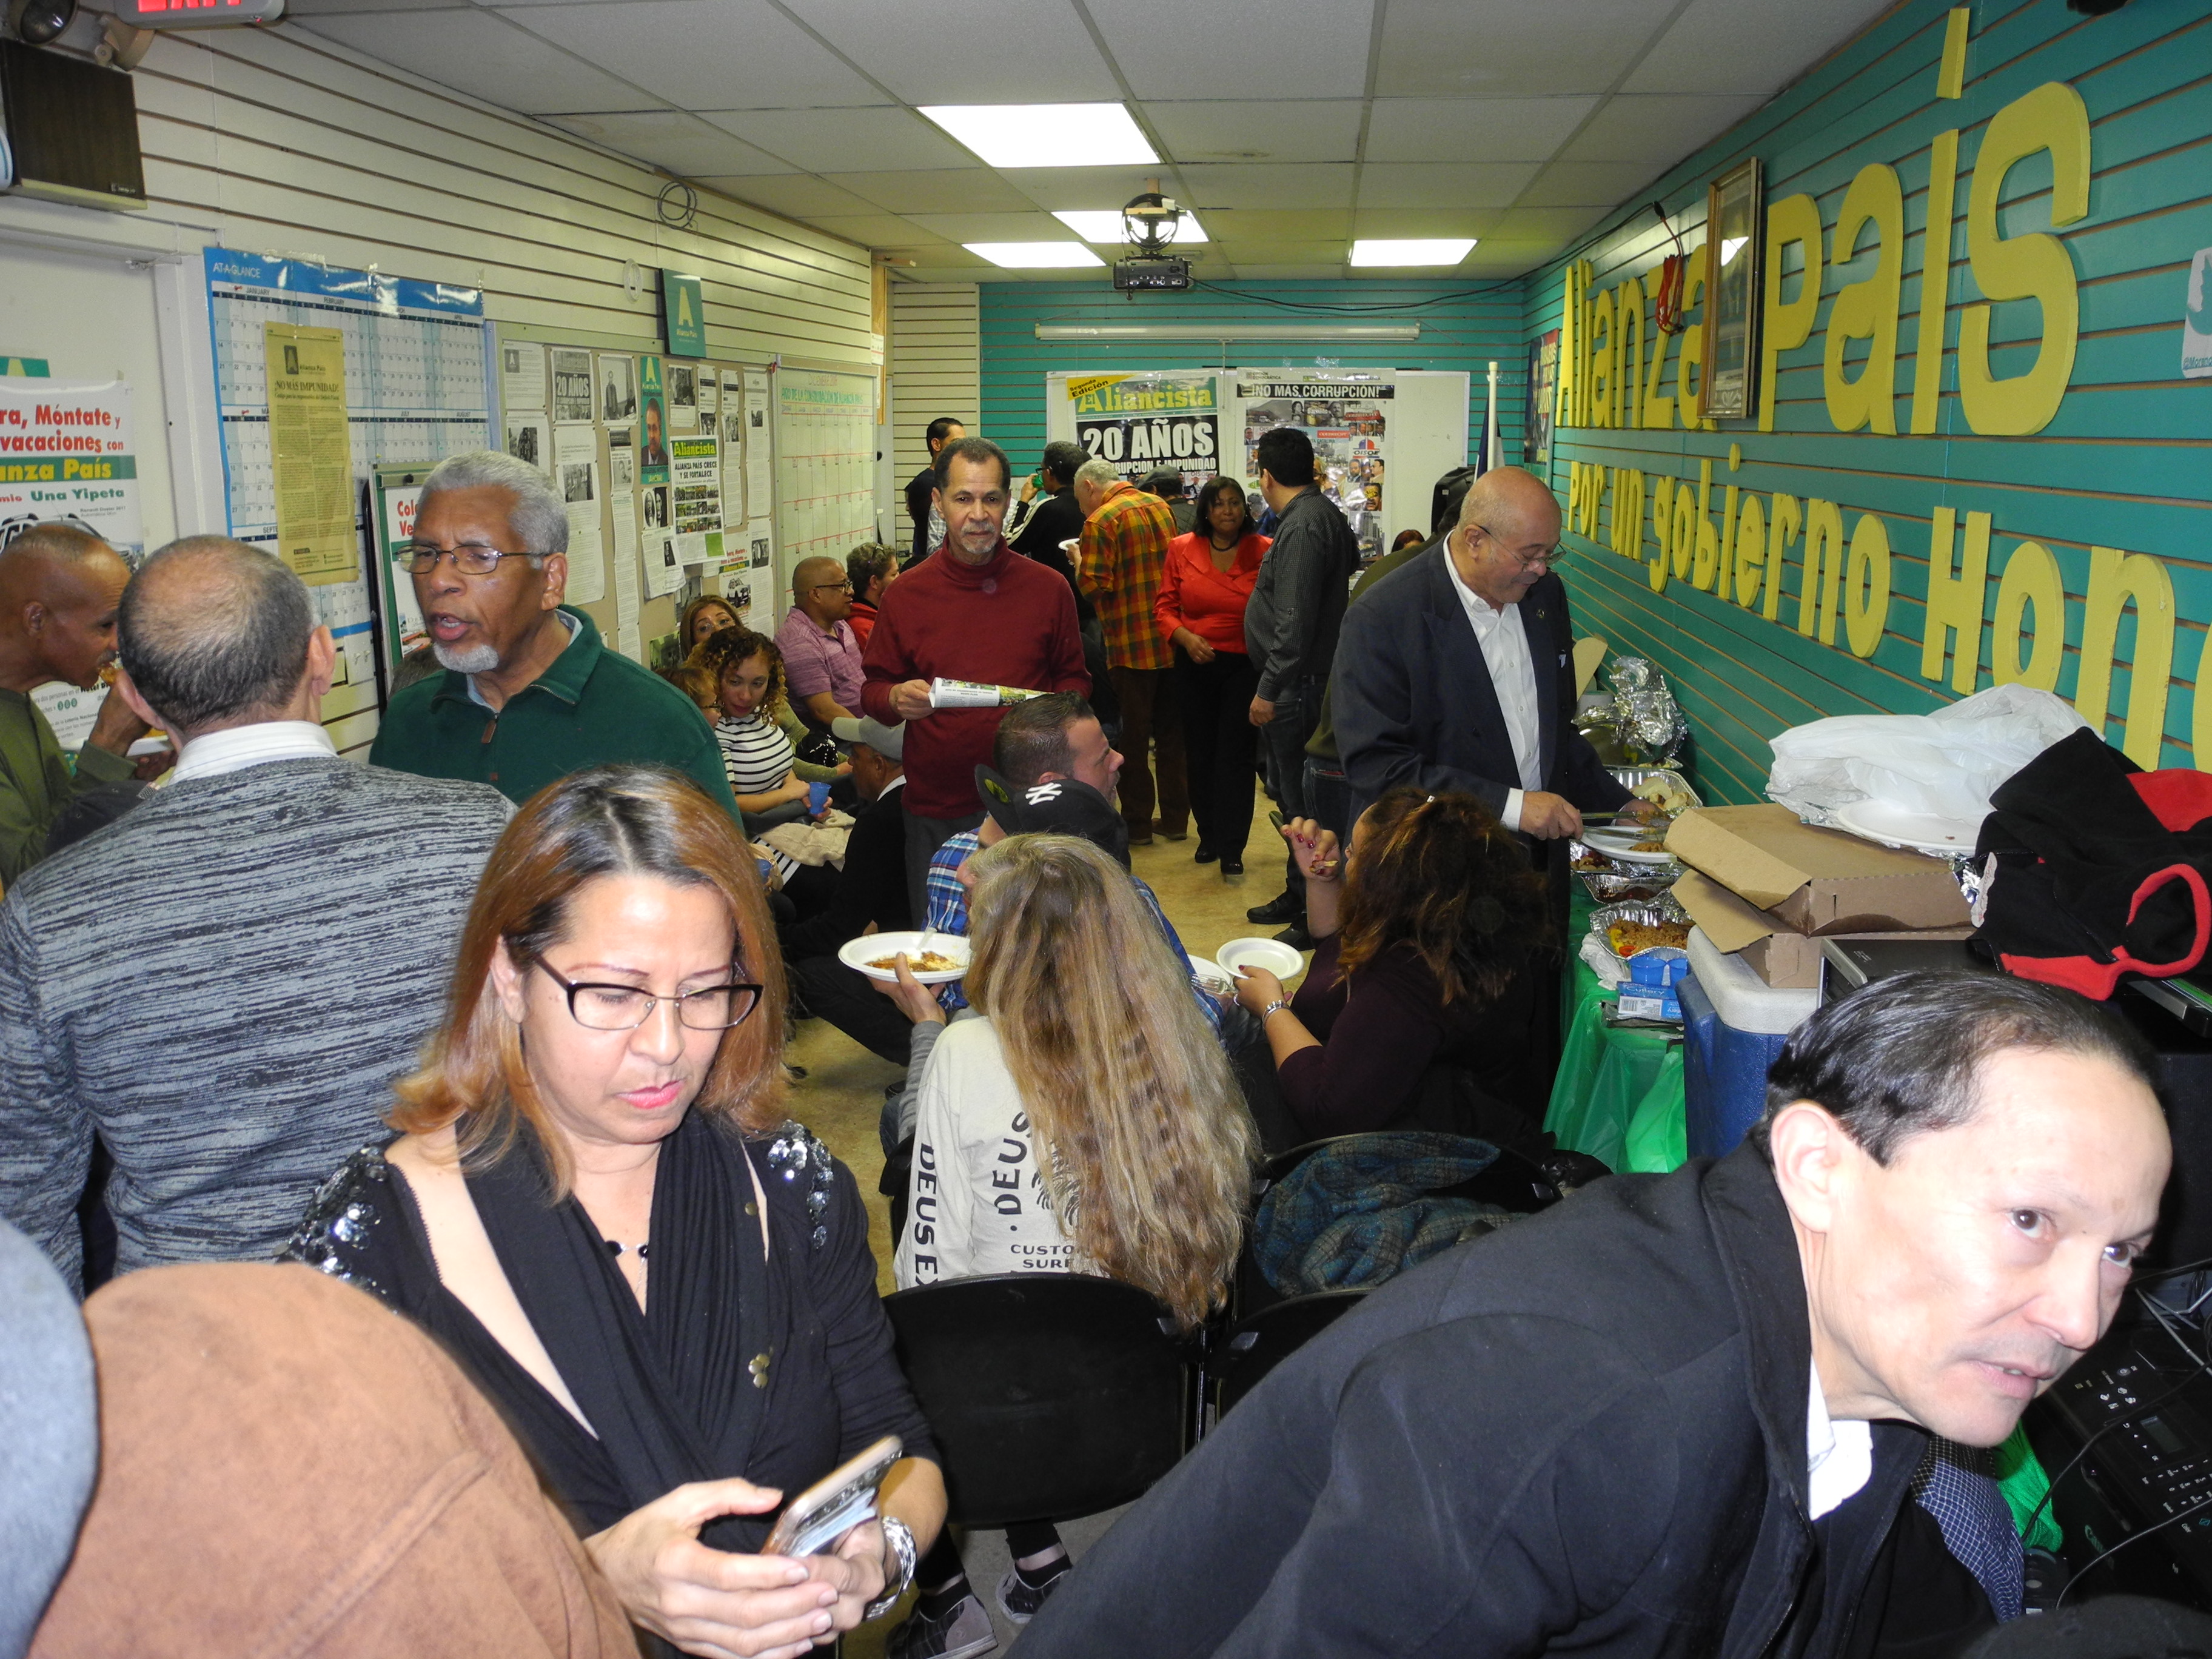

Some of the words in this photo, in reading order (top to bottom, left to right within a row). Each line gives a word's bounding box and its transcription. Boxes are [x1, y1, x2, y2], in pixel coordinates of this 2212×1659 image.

[1555, 244, 1717, 431] Alianza
[1758, 7, 2091, 437] País
[246, 287, 270, 296] JANUARY
[286, 378, 299, 390] MÁS
[300, 381, 340, 392] IMPUNIDAD!
[557, 375, 568, 396] 20
[568, 374, 589, 397] AÑOS
[1070, 378, 1096, 392] Segunda
[1071, 380, 1108, 398] Edición
[1302, 384, 1380, 398] CORRUPCIÓN!
[1078, 384, 1212, 413] Aliancista
[35, 404, 112, 426] Móntate
[115, 417, 121, 429] y
[0, 429, 102, 454] vacaciones
[107, 440, 124, 451] con
[674, 441, 716, 456] Aliancista
[1083, 426, 1124, 461] 20
[1131, 418, 1214, 460] AÑOS
[64, 457, 112, 480] País
[692, 460, 703, 469] PAÍS
[1113, 460, 1154, 475] RUPCION
[1164, 457, 1216, 472] IMPUNIDAD
[689, 470, 712, 478] FORTALECE
[31, 490, 67, 501] Una
[72, 488, 125, 502] Yipeta
[399, 520, 414, 537] Ve
[1567, 460, 1609, 542] Por
[1610, 460, 1645, 561] un
[1649, 442, 1892, 659] gobierno
[1921, 506, 2212, 779] Hon
[993, 1110, 1031, 1215] DEUS
[914, 1142, 937, 1245] DEUS
[1010, 1244, 1075, 1256] CUSTO
[1022, 1259, 1074, 1269] SURF
